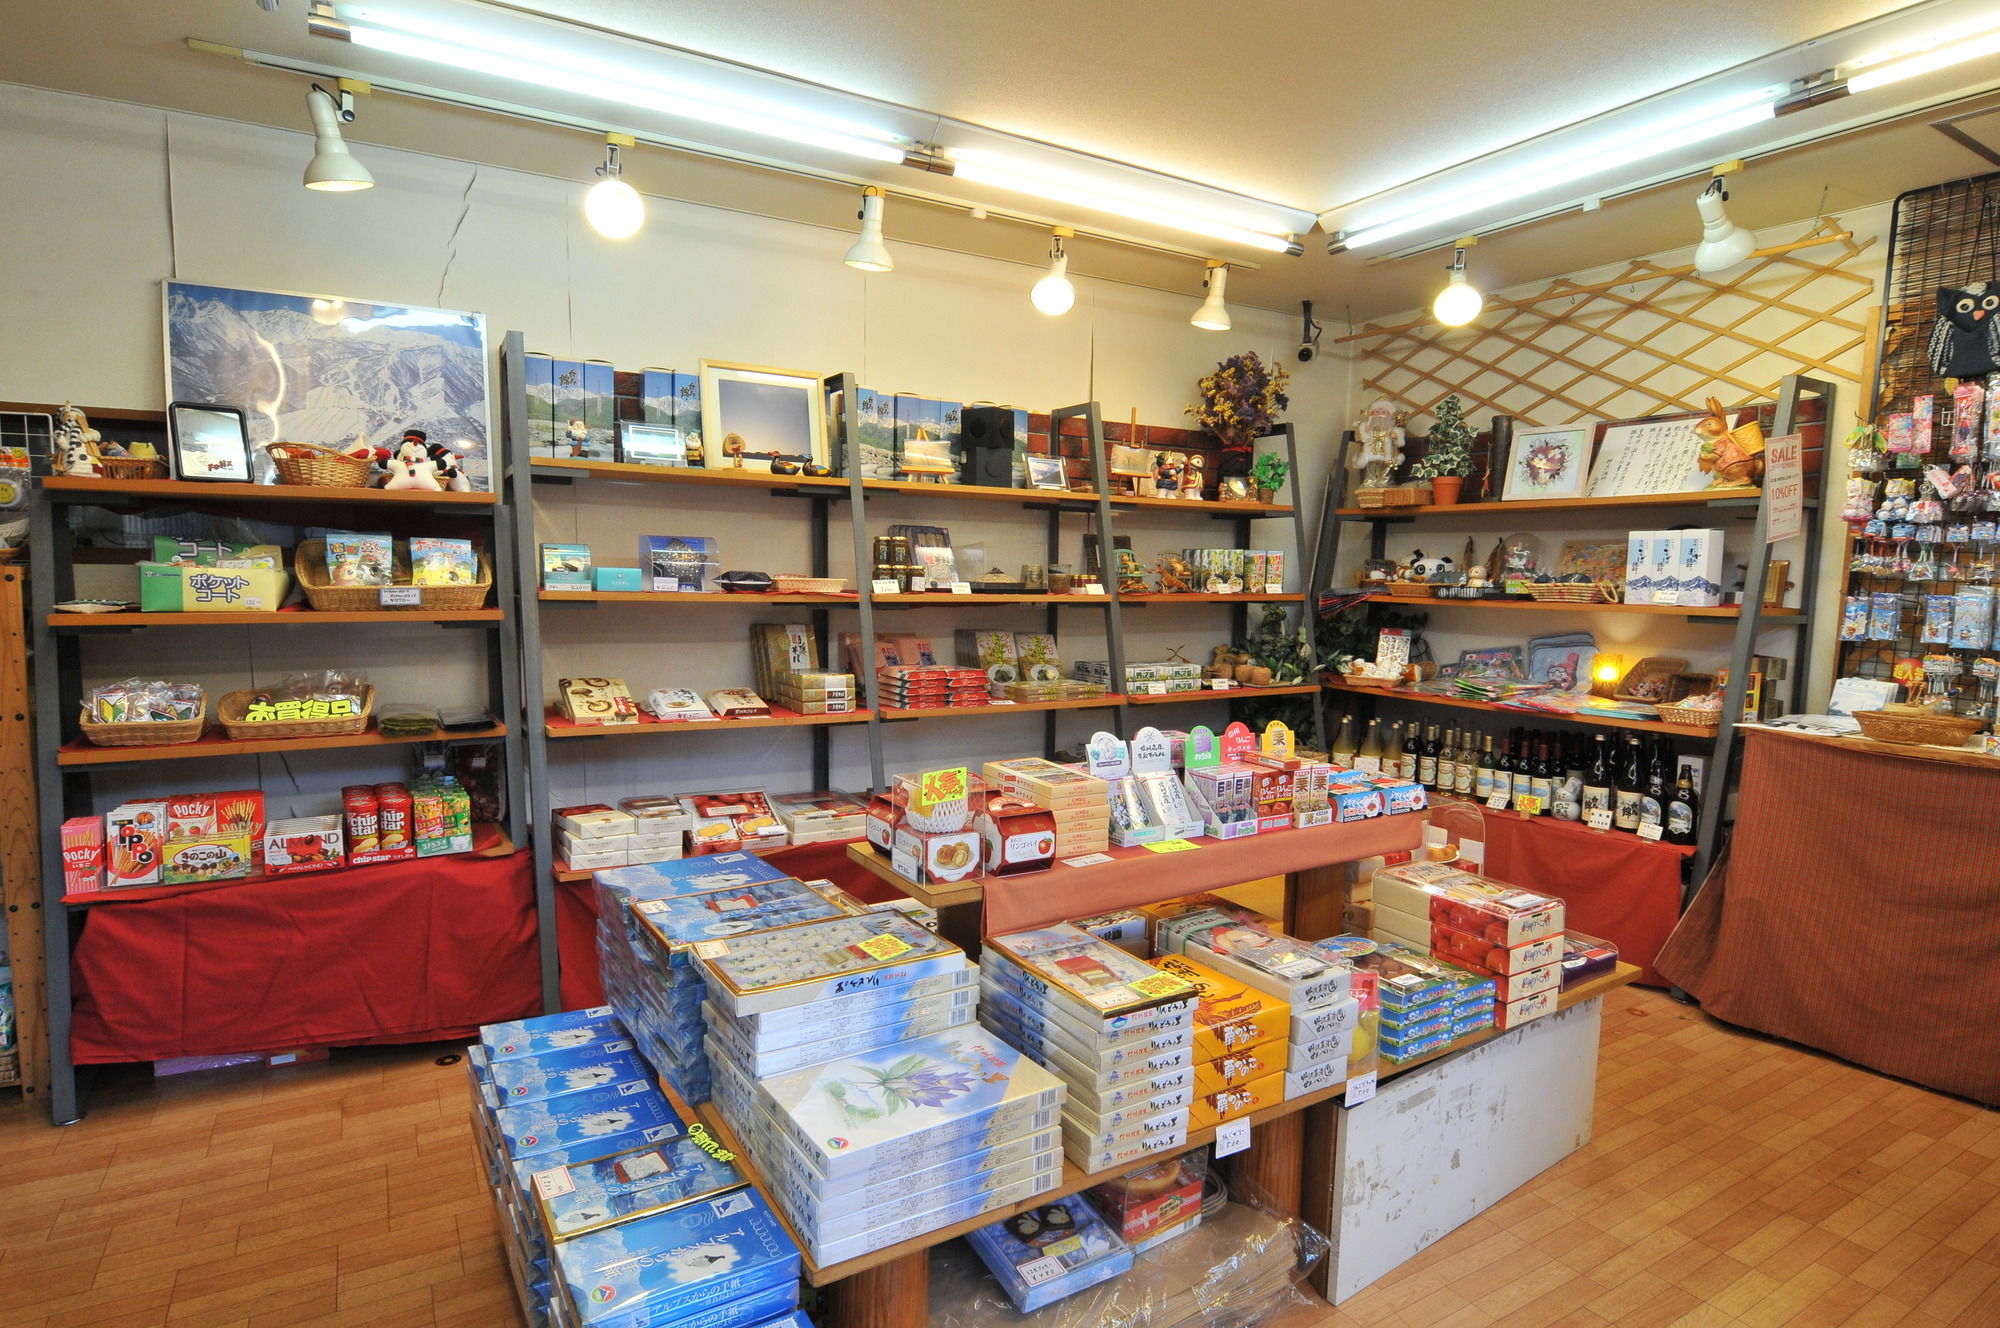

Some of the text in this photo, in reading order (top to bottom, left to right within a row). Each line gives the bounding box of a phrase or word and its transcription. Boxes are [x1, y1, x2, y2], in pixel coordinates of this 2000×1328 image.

[1771, 445, 1798, 464] SALE
[1771, 484, 1798, 501] 10%OFF
[178, 542, 233, 558] コート
[190, 574, 249, 590] ポケット
[196, 589, 240, 603] コート
[245, 699, 356, 721] お買得品
[1272, 729, 1286, 746] 栗
[1295, 776, 1309, 793] 栗
[1313, 775, 1328, 791] 栗
[351, 814, 378, 828] chip
[351, 824, 378, 836] star
[1010, 840, 1038, 850] リンゴパイ
[181, 848, 227, 865] きのこの山
[653, 1278, 742, 1315] アルプスからの手紙
